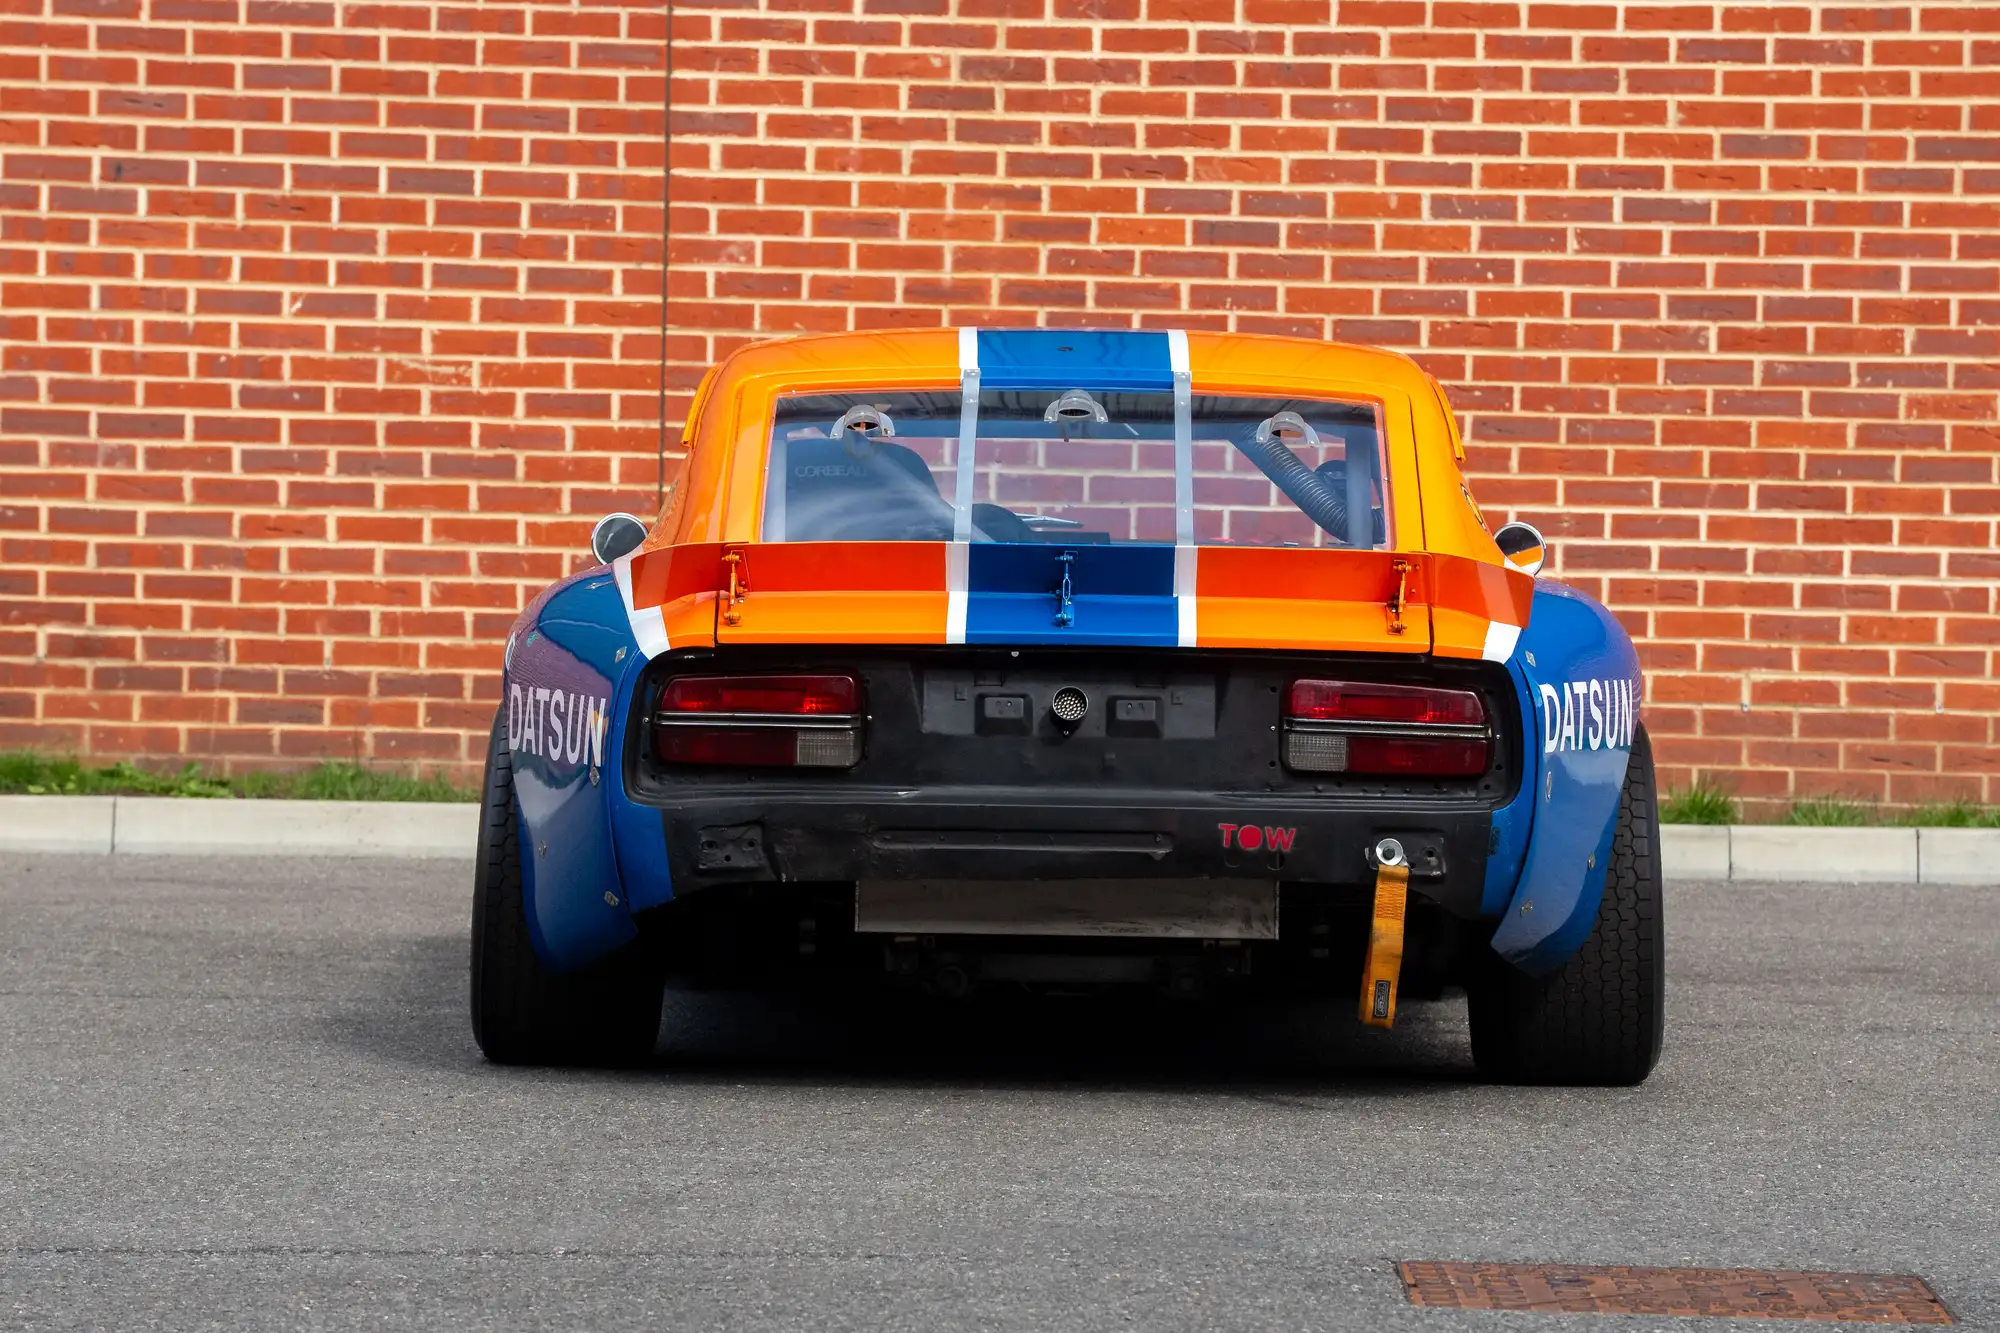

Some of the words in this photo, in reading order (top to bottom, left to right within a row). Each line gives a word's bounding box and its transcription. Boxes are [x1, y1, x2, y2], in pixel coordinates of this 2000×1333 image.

[795, 465, 867, 478] CORBEAU
[508, 683, 606, 767] DATSUN
[1539, 679, 1632, 753] DATSUN
[1218, 823, 1296, 851] TOW
